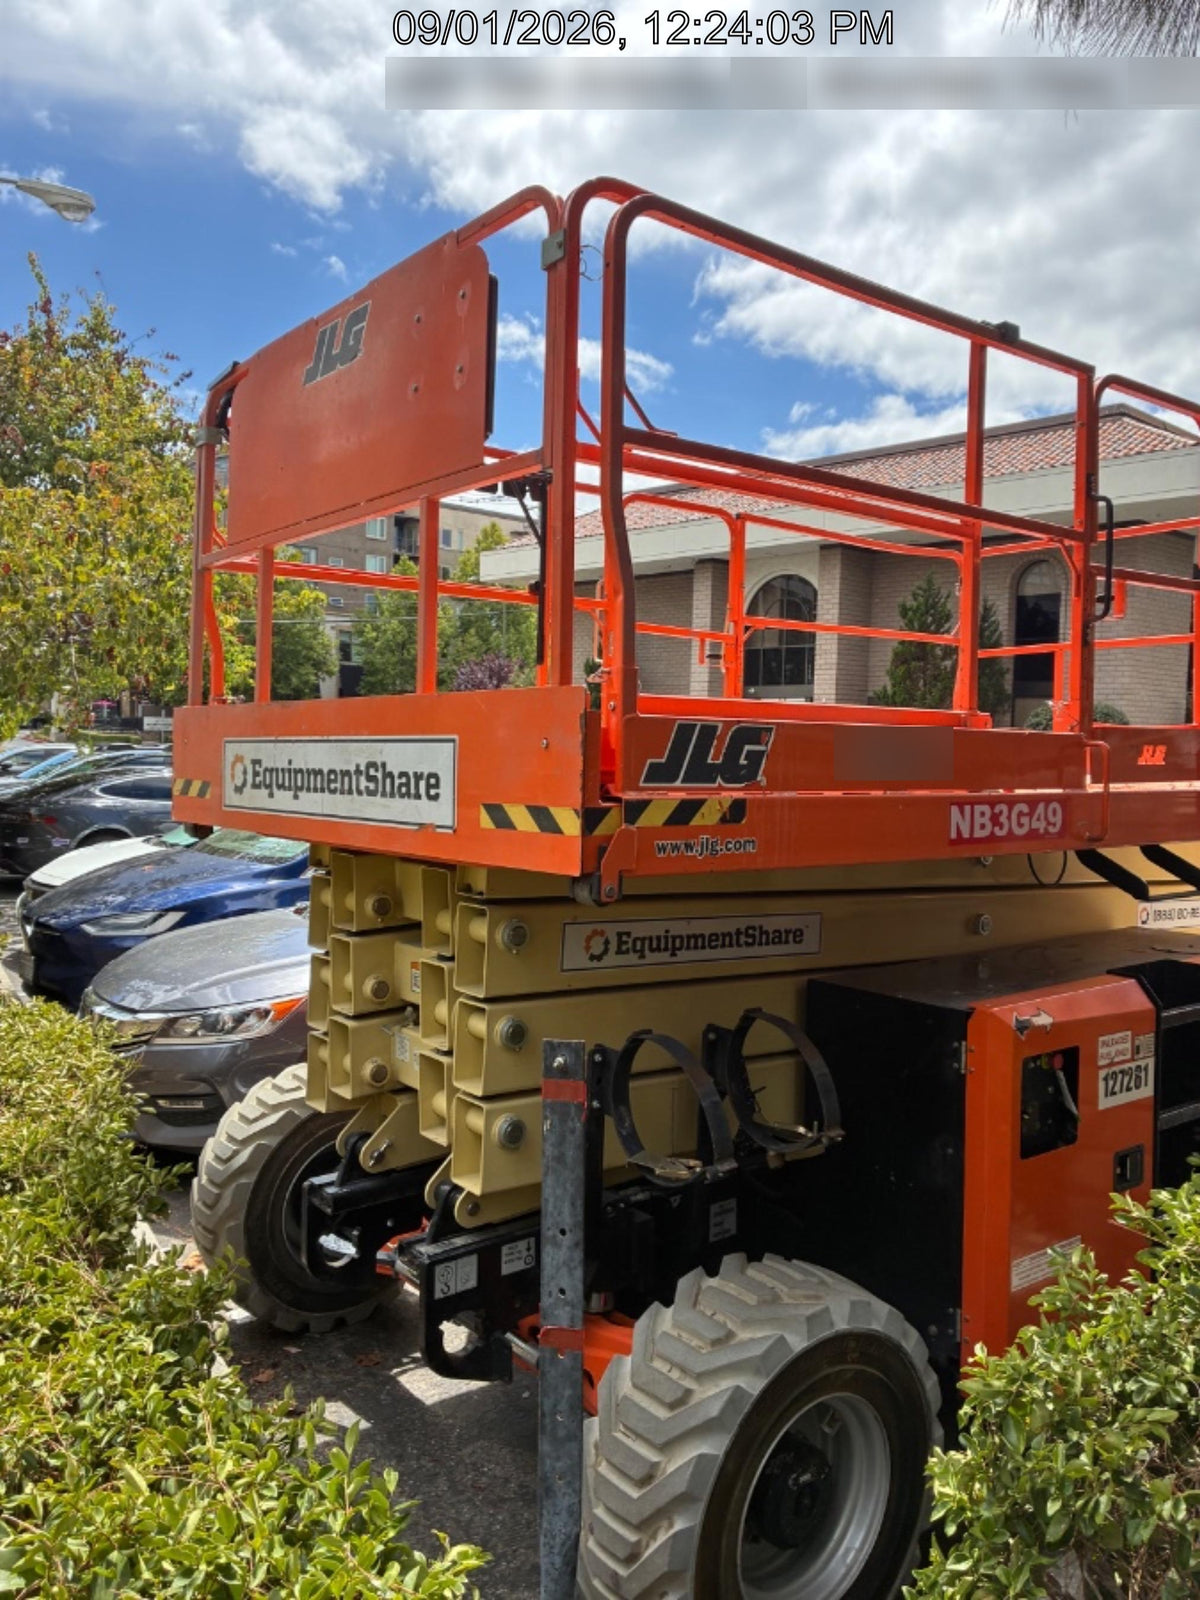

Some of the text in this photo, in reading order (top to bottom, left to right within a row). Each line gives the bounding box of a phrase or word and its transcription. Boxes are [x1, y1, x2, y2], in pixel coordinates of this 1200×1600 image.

[302, 299, 372, 386] JLG
[640, 720, 775, 786] JLG
[250, 758, 441, 802] EquipmentShare
[949, 802, 1063, 839] NB3G49
[655, 835, 757, 858] www.jlg.com
[615, 925, 804, 959] EquipmentShare
